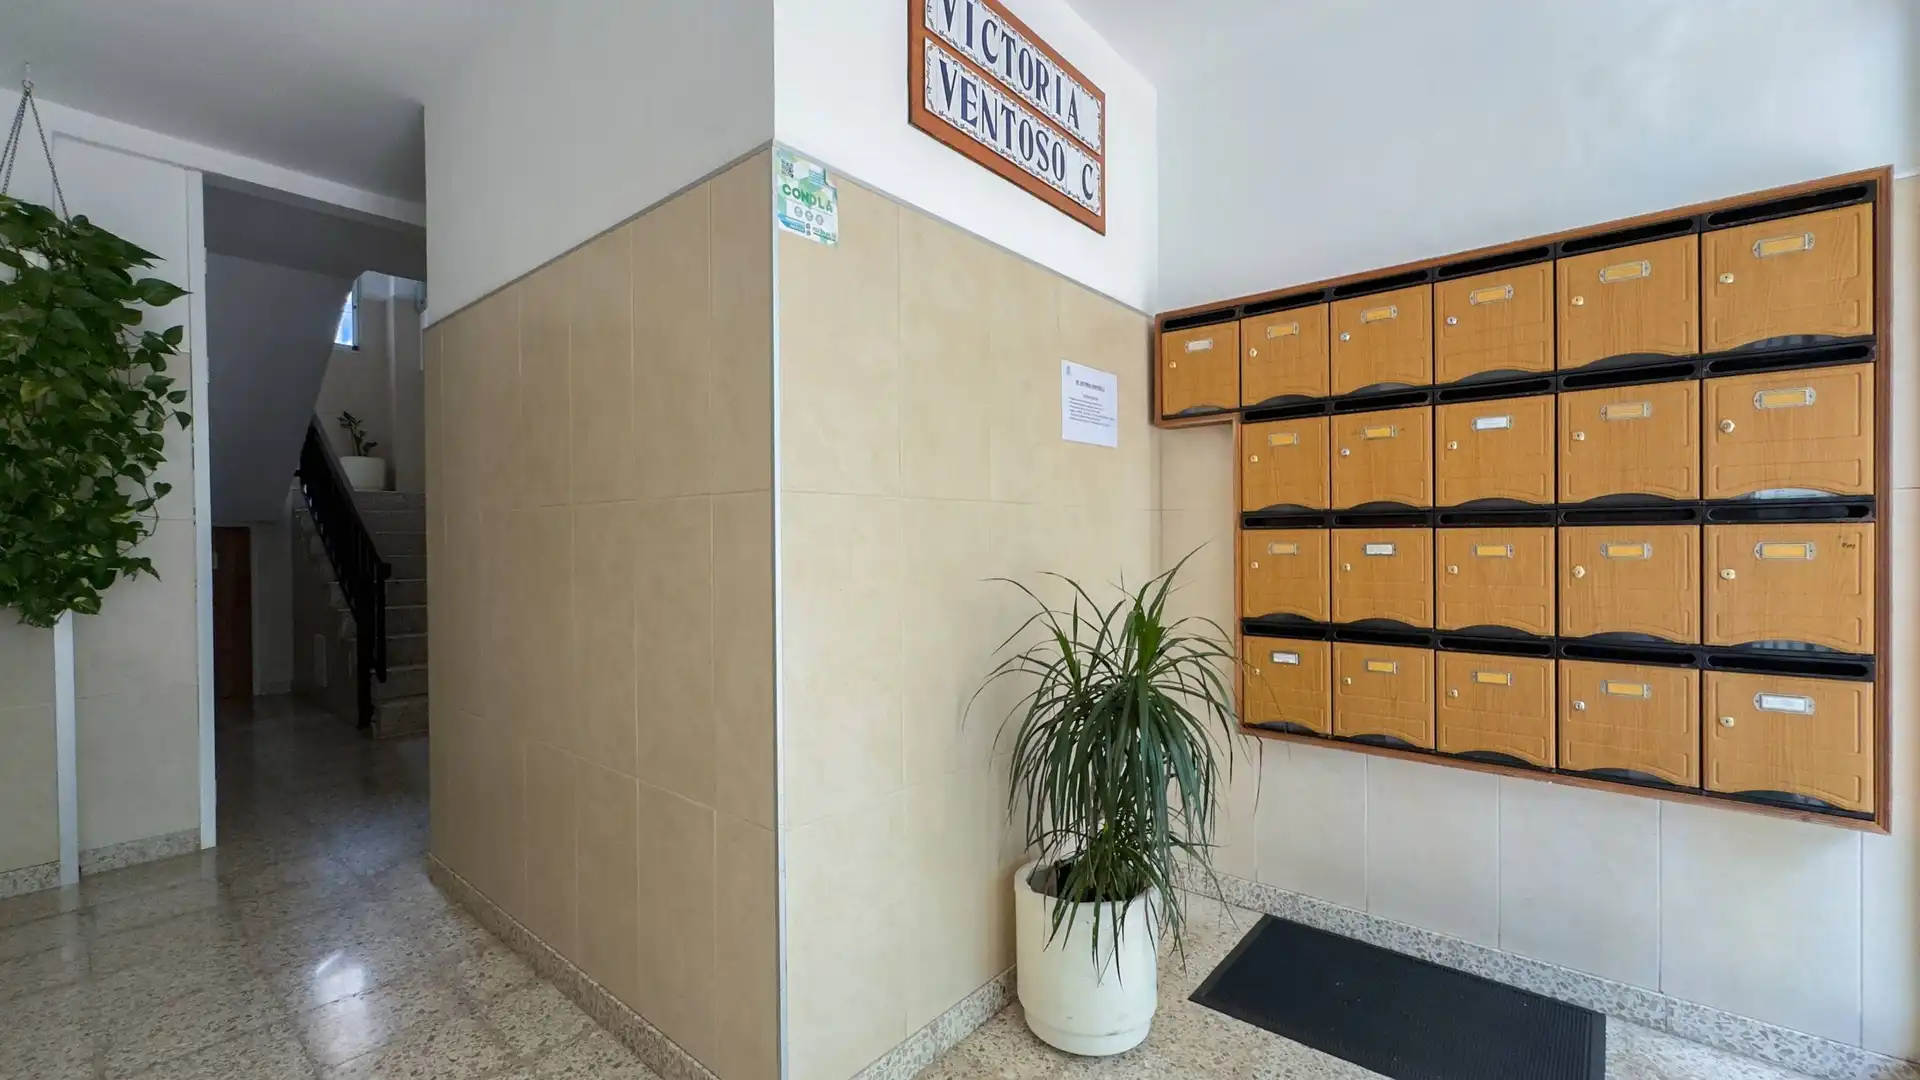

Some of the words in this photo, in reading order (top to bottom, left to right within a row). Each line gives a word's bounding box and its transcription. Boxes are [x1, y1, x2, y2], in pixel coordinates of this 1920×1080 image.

[938, 0, 1080, 130] VICTORIA
[939, 59, 1065, 182] VENTOSO
[1082, 163, 1094, 201] C
